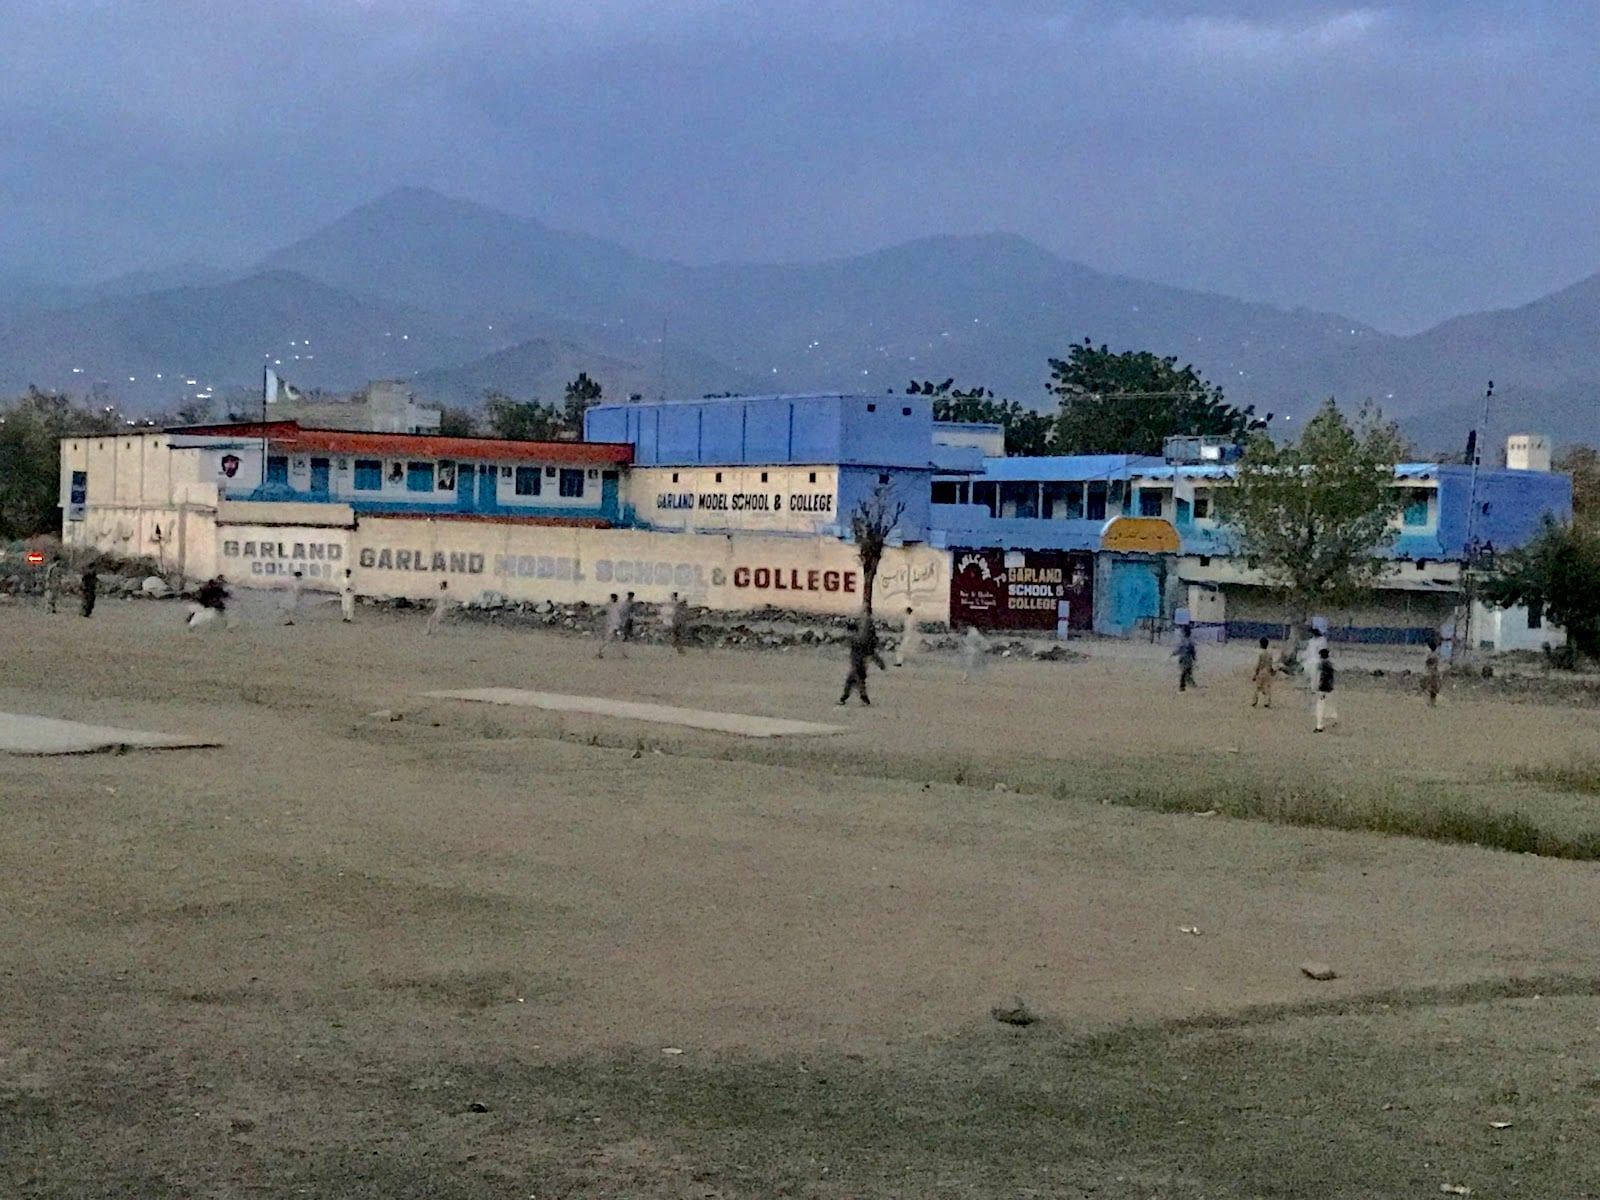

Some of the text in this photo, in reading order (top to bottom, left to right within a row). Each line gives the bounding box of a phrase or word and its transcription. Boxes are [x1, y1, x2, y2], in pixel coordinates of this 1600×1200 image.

[657, 493, 833, 512] GARLAND MODEL SCHOOL & COLLEGE
[223, 540, 343, 560] GARLAND
[359, 547, 485, 574] GARLAND
[712, 567, 727, 586] &
[734, 566, 857, 593] COLLEGE
[1008, 568, 1062, 583] GARLAND
[1008, 584, 1054, 597] SCHOOL
[1055, 585, 1065, 597] &
[1008, 598, 1057, 610] COLLEGE
